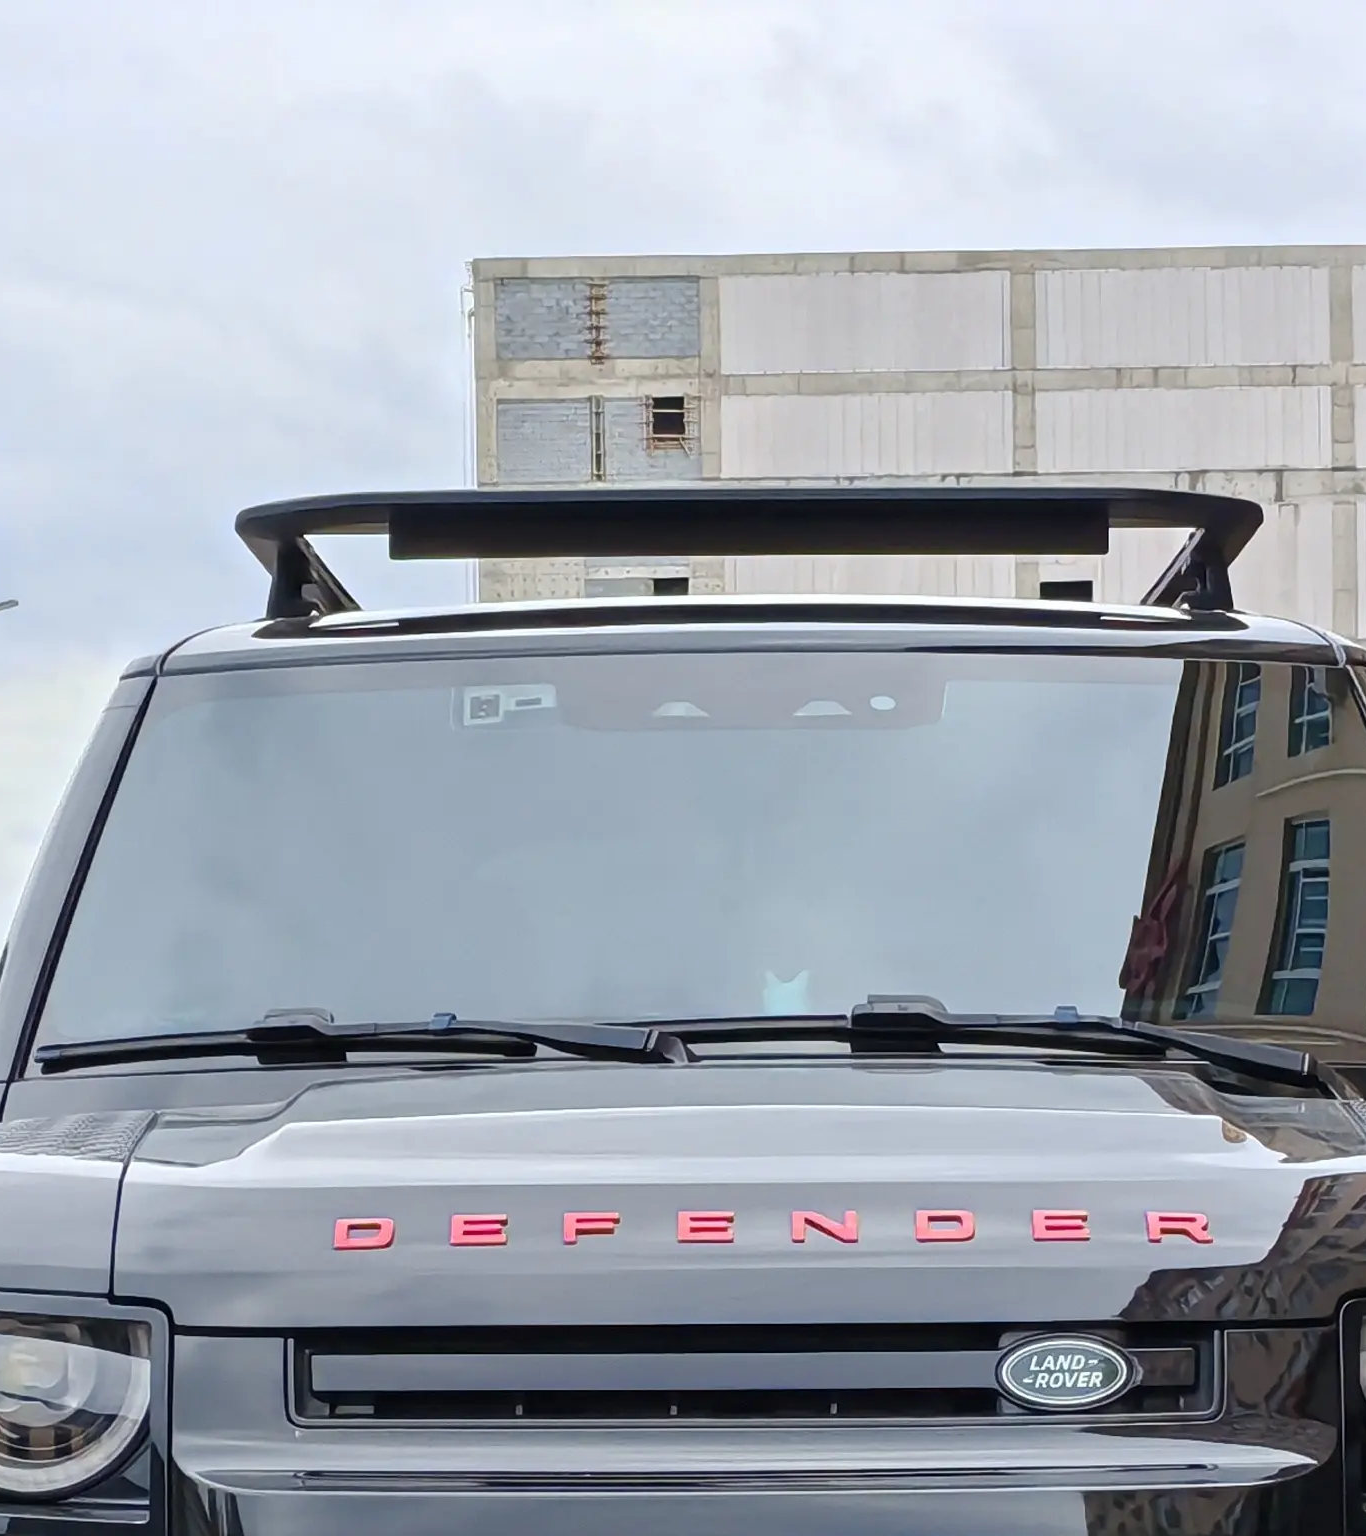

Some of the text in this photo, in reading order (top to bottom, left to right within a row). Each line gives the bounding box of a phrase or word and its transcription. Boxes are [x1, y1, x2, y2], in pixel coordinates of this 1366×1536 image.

[333, 1209, 1215, 1250] DEFENDER
[1029, 1354, 1085, 1371] LAND
[1035, 1371, 1104, 1389] ROVER
